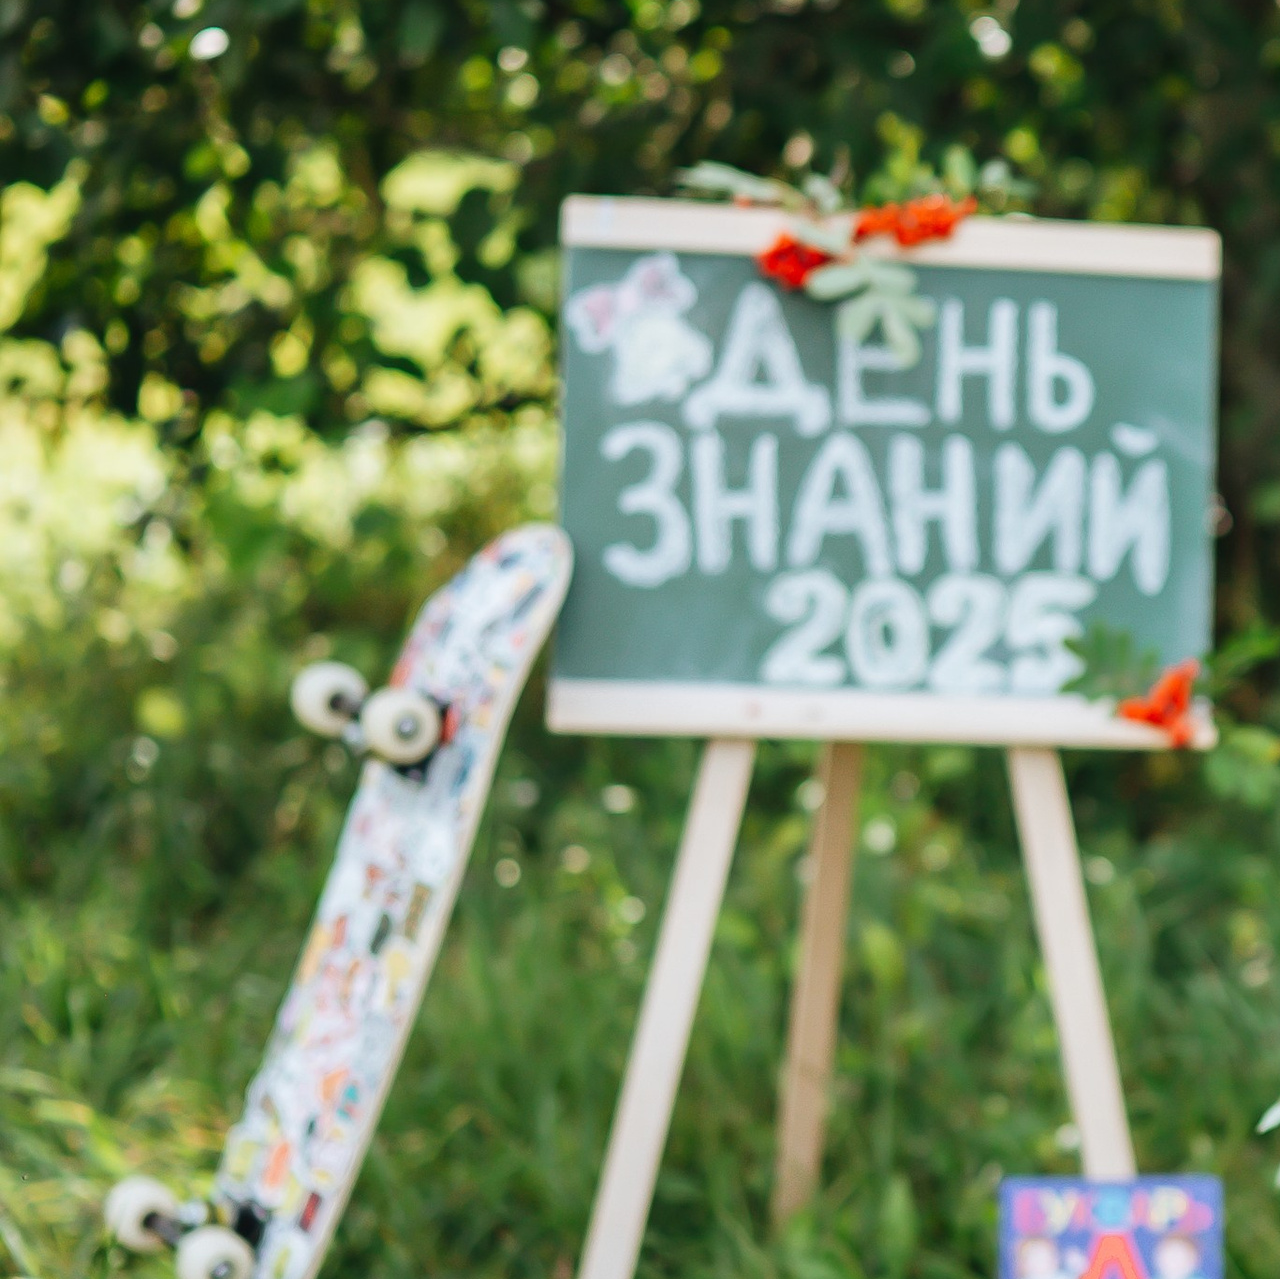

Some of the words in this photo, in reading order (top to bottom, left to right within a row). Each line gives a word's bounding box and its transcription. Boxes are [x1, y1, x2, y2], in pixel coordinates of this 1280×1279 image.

[682, 281, 1095, 436] ДЕНЬ
[603, 421, 1171, 595] ЗНАНИЙ
[759, 568, 1096, 692] 2025
